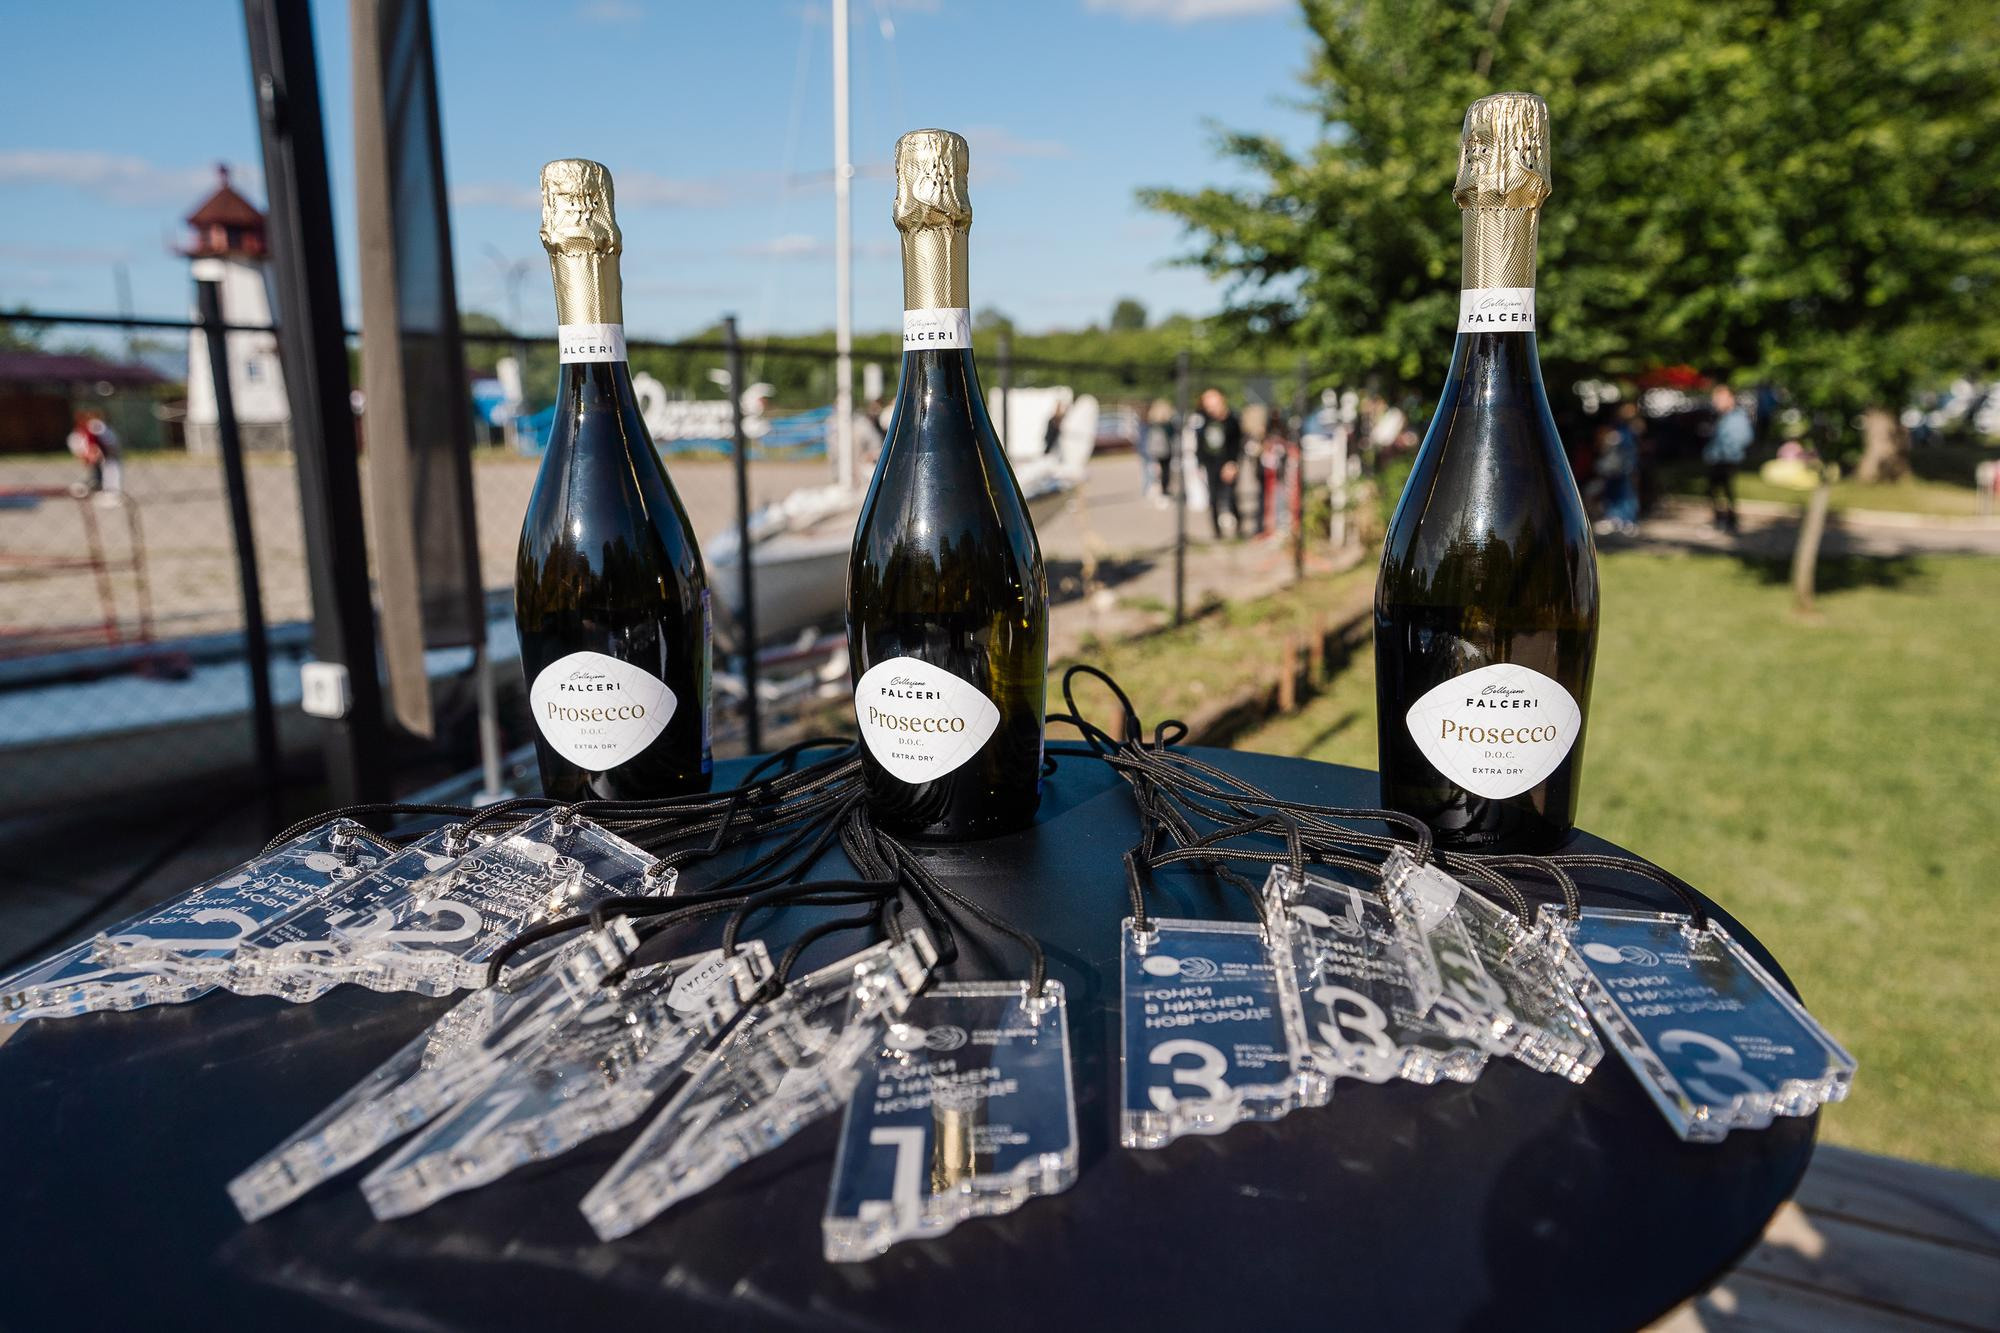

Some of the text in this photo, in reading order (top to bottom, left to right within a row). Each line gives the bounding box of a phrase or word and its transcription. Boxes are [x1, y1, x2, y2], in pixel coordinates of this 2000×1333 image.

[1468, 313, 1532, 323] FALCERI
[904, 331, 953, 342] ALCERI
[561, 345, 613, 354] ALCERI
[560, 683, 620, 692] FALCERI
[881, 688, 940, 699] FALCERI
[1466, 698, 1538, 709] FALCERI
[547, 701, 645, 722] Prosecco
[869, 706, 965, 733] Prosecco
[580, 727, 606, 735] D.O.C.
[1441, 719, 1557, 744] Prosecco
[898, 737, 924, 746] D.O.C.
[891, 752, 915, 761] EXTRA
[1484, 751, 1515, 759] D.O.C.
[1472, 767, 1502, 775] EXTRA
[1144, 986, 1212, 1001] ГОНКИ
[1164, 995, 1254, 1013] НИЖНЕМ
[1145, 1007, 1272, 1029] НОВГОРОДЕ
[1149, 1038, 1236, 1130] 3
